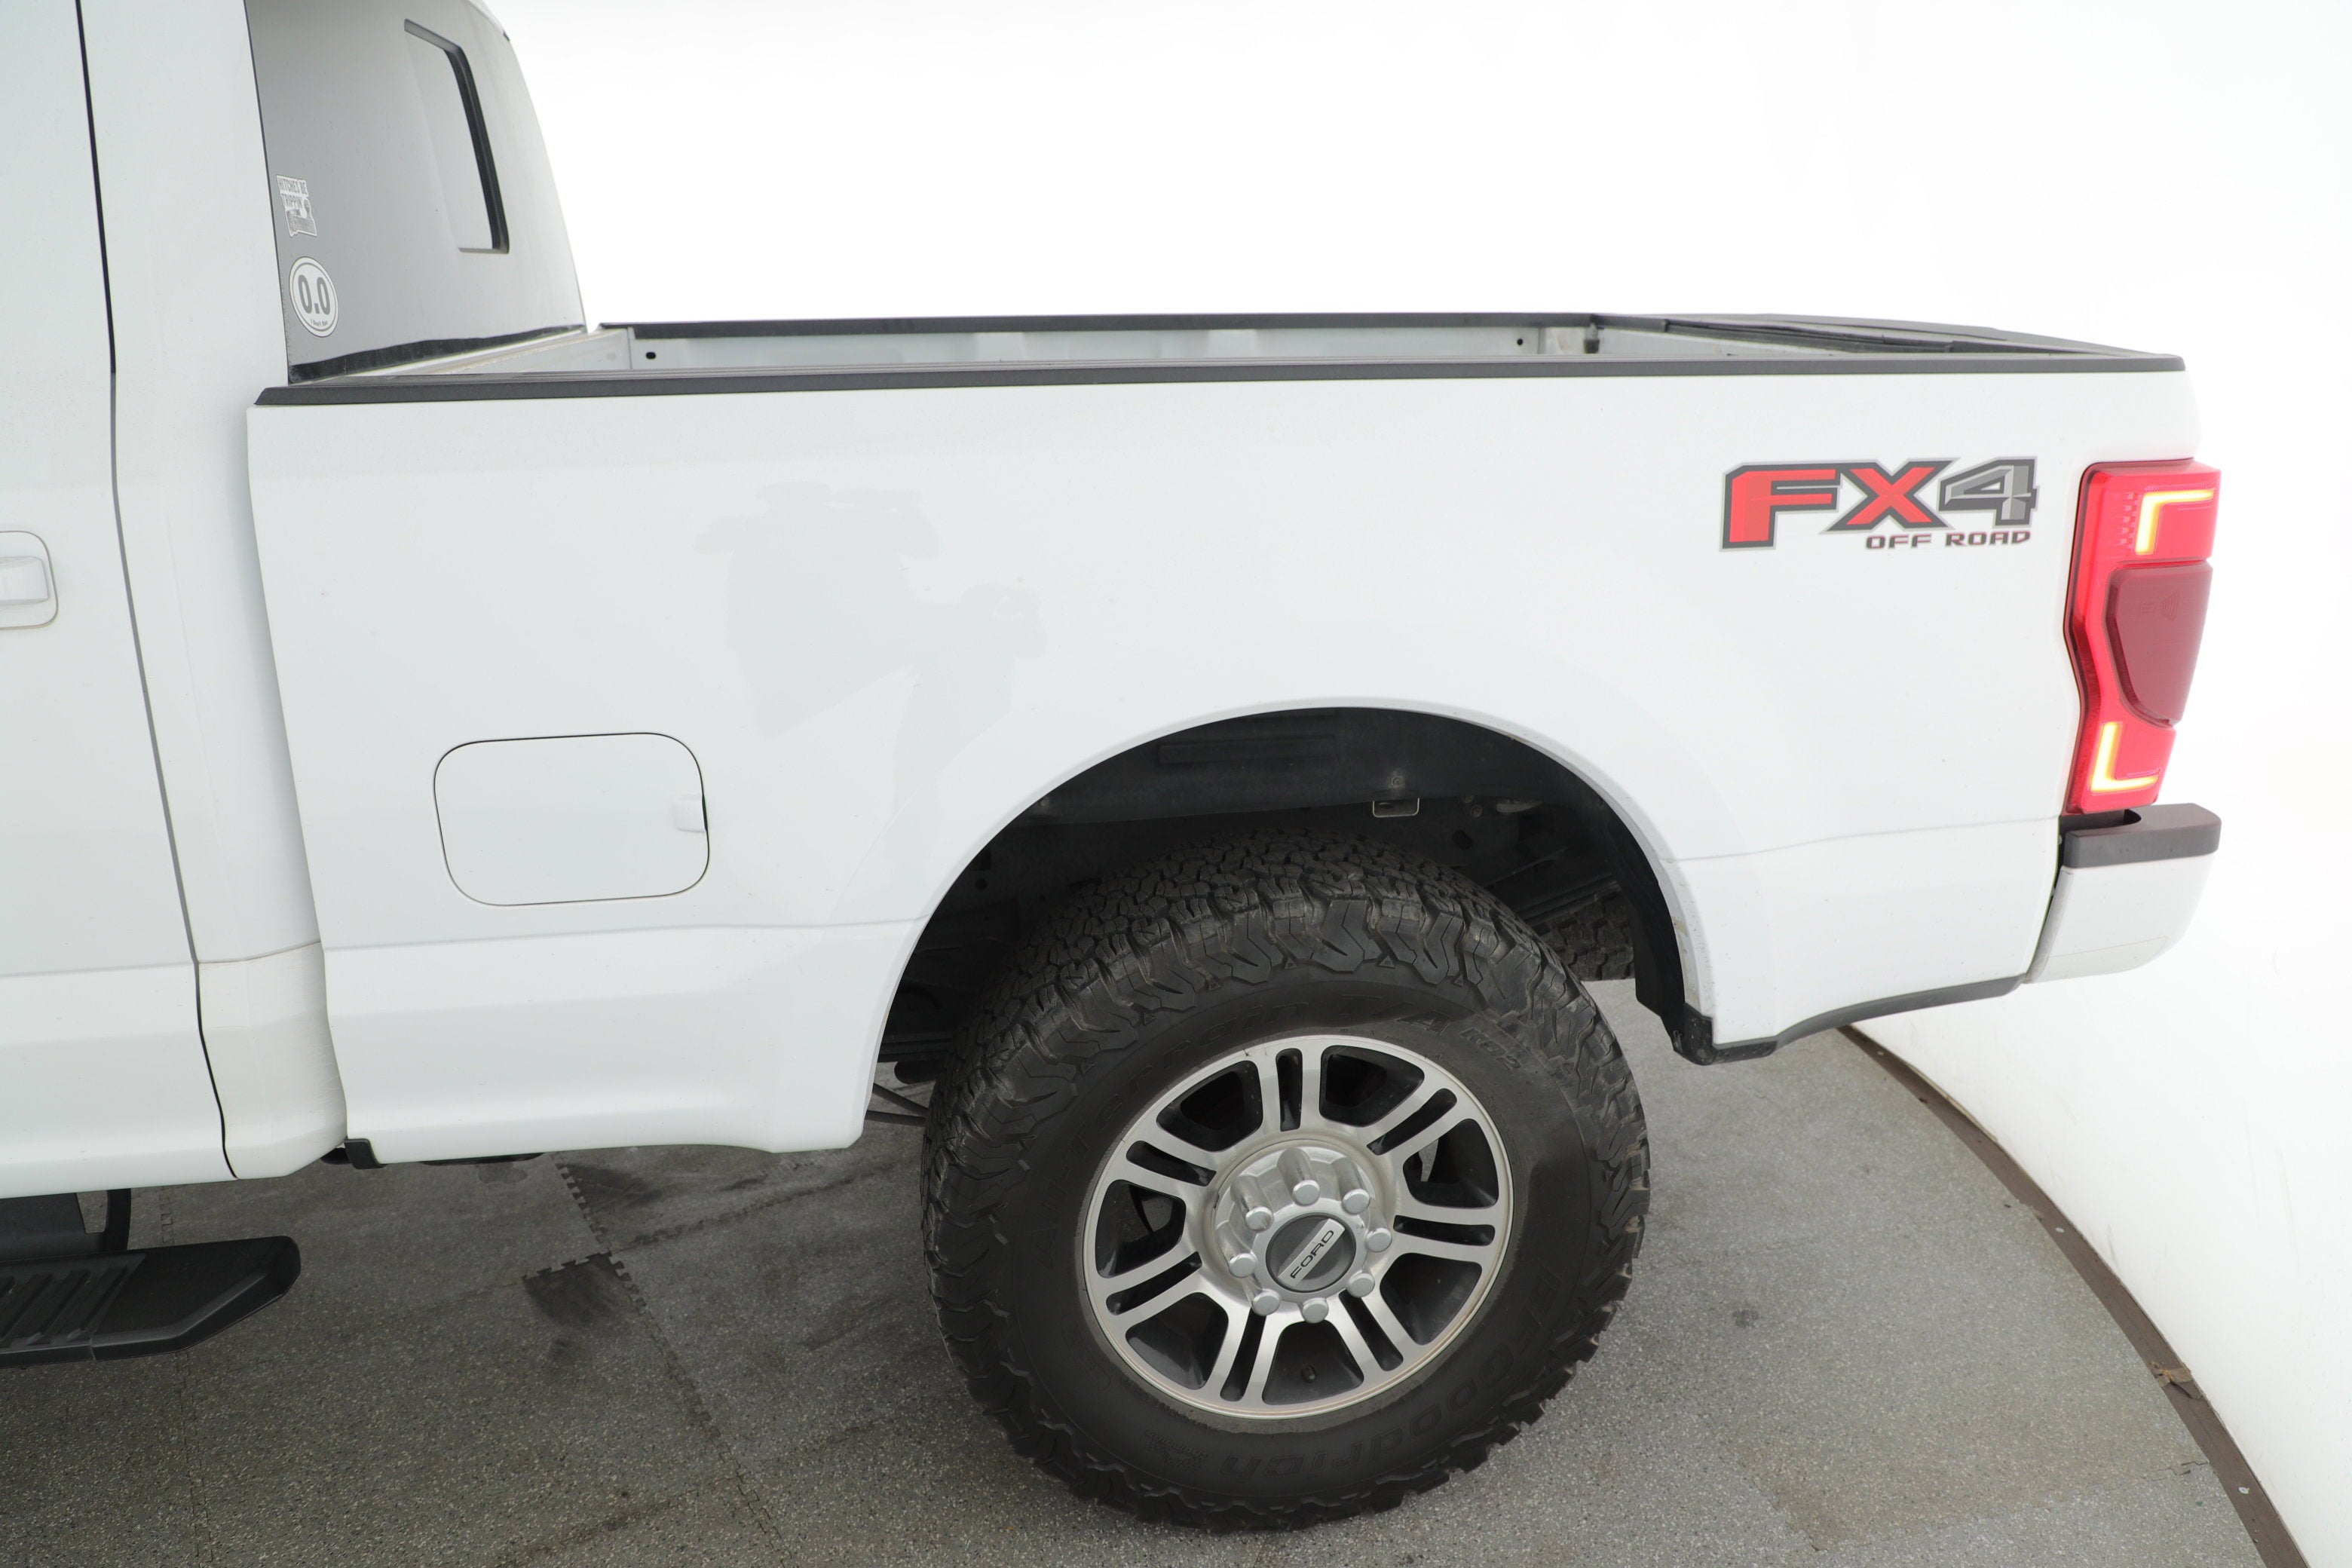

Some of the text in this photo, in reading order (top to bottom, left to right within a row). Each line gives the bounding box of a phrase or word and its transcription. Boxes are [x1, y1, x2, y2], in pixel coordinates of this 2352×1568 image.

[298, 274, 331, 315] 0.0
[1720, 457, 2038, 551] FX4
[1865, 531, 2031, 550] OFF ROAD
[1290, 1230, 1334, 1279] FORD
